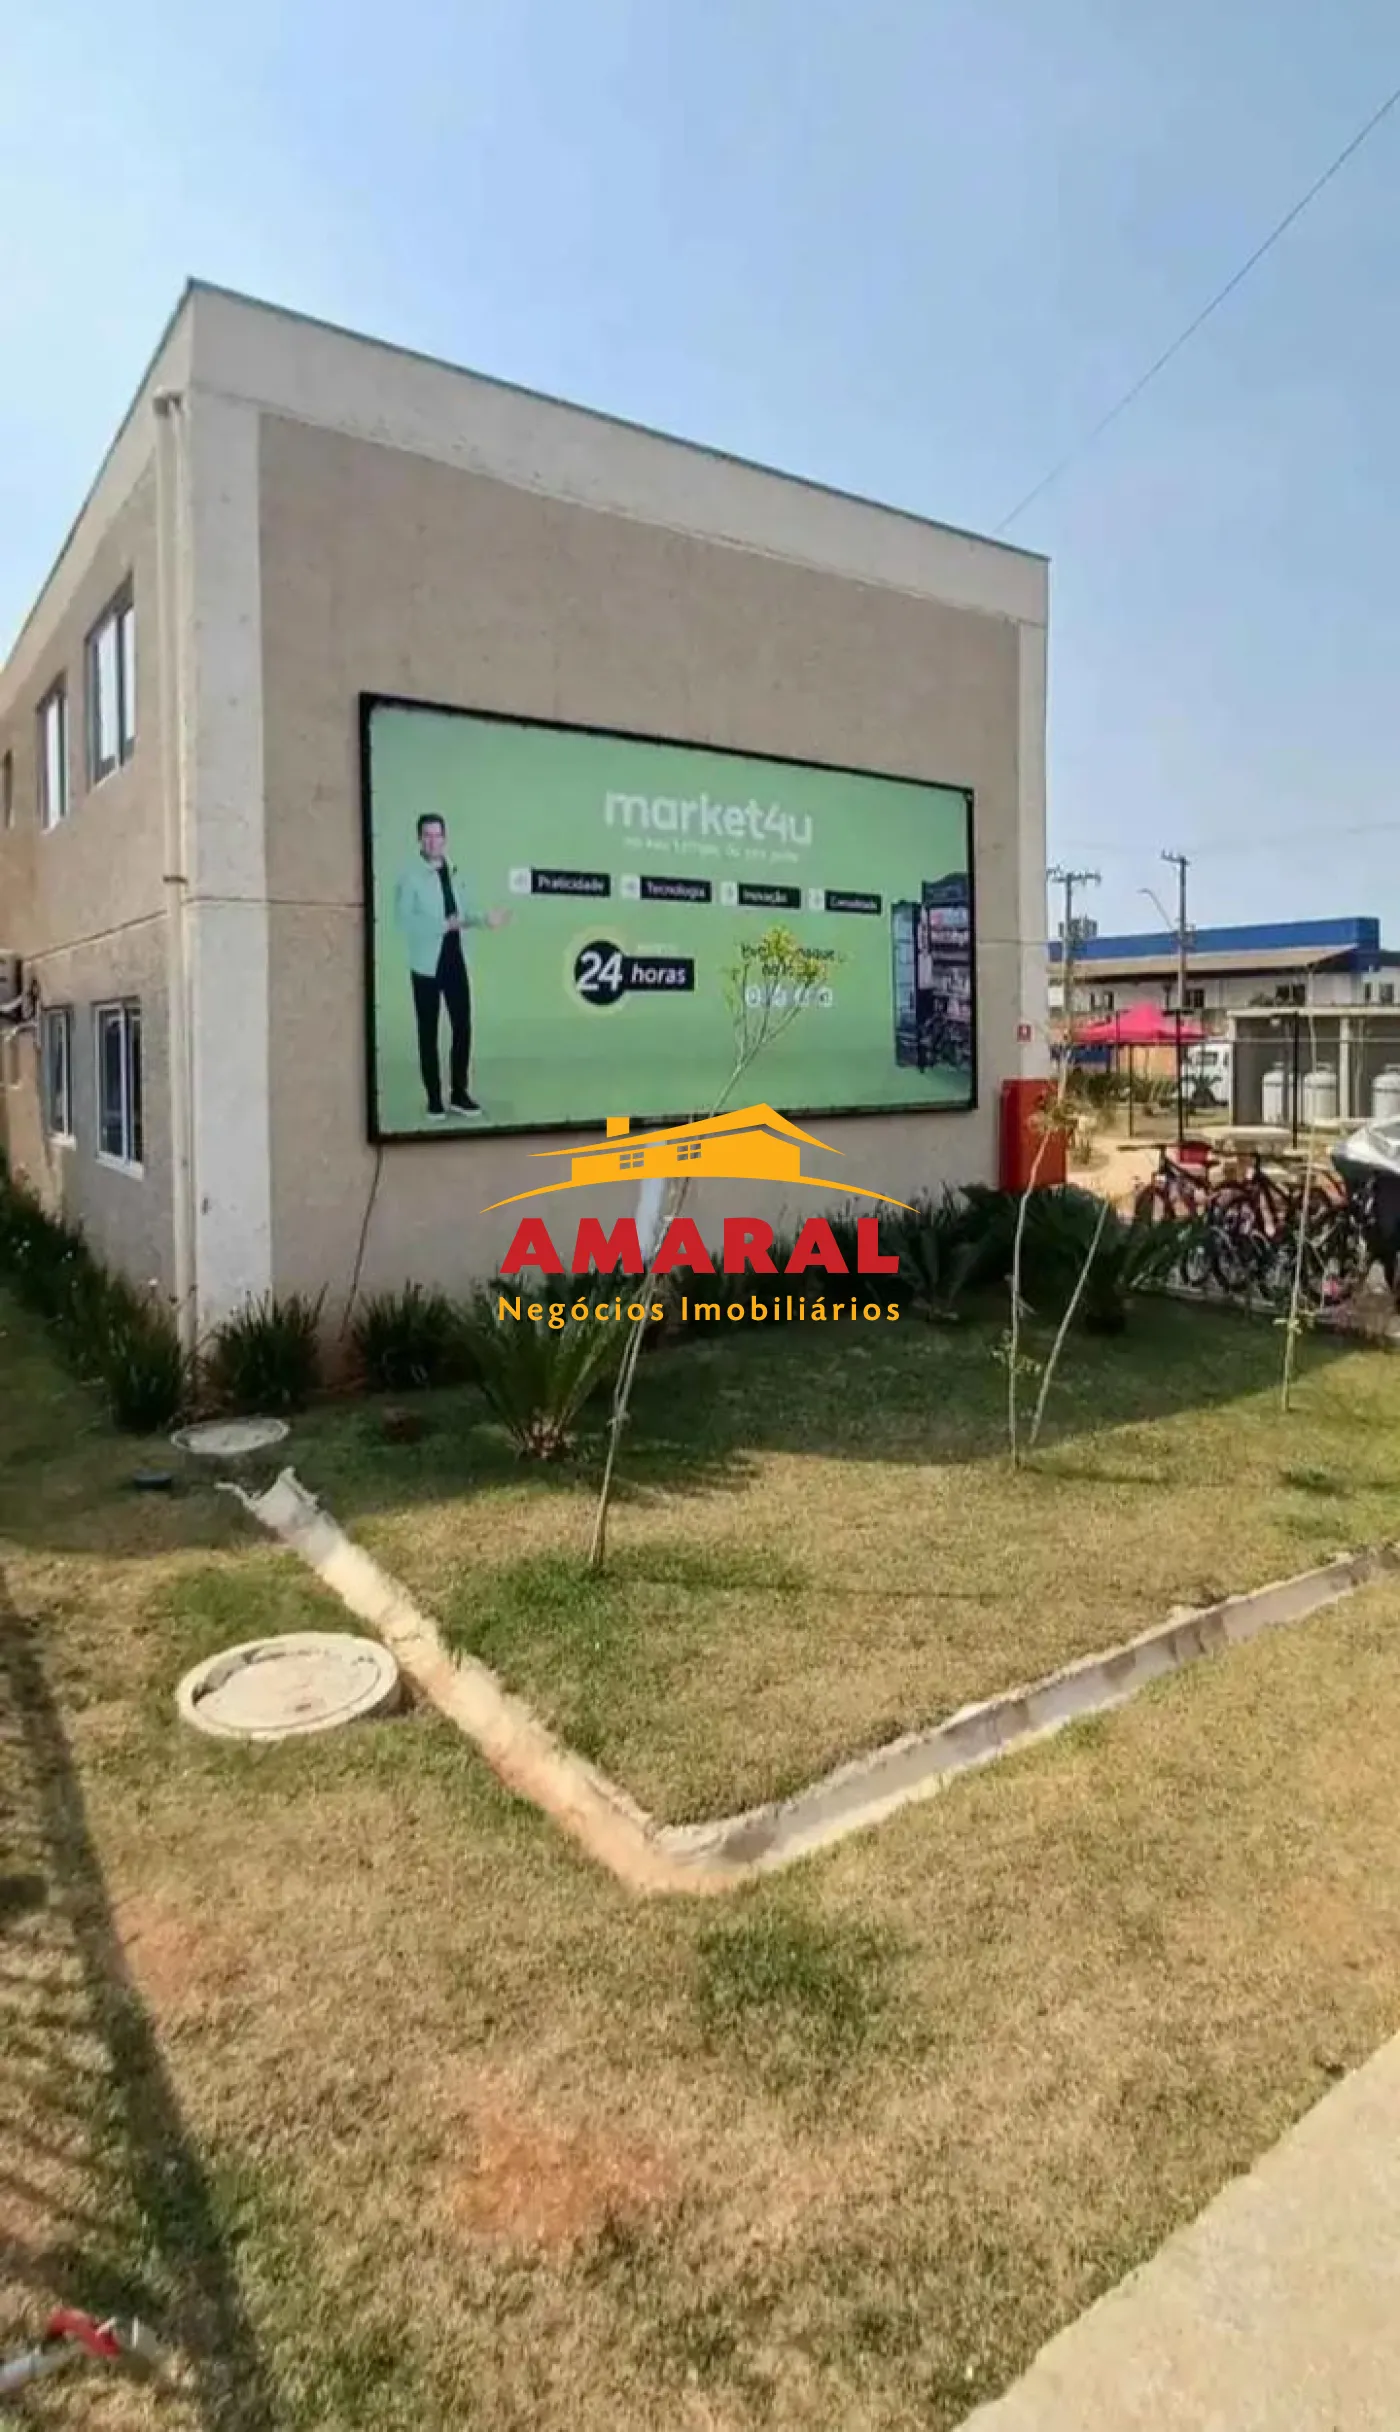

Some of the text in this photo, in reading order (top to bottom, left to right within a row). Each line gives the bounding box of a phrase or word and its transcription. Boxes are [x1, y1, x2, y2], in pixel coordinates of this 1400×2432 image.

[604, 791, 813, 847] market4u
[576, 950, 686, 992] 24 horas
